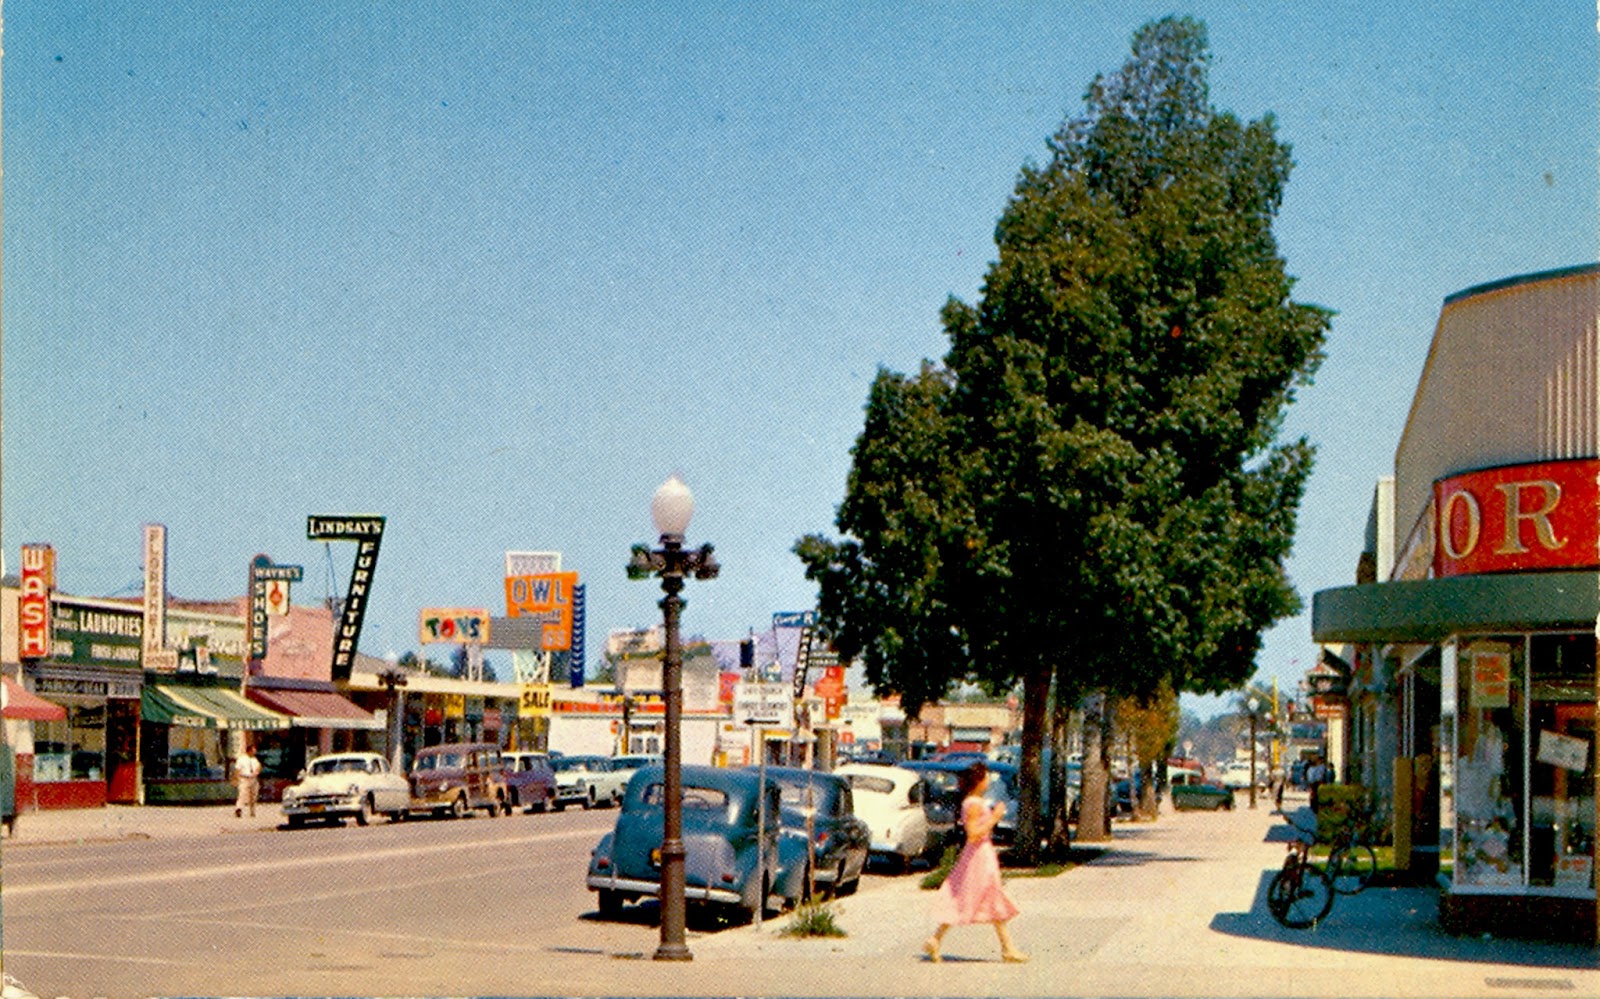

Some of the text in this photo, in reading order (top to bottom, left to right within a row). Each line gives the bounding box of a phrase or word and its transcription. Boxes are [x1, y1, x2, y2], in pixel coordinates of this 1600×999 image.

[308, 517, 382, 536] LINDSAY'S
[22, 549, 45, 652] WASH
[335, 541, 375, 667] FURNITURE
[512, 579, 567, 604] OWL
[79, 609, 143, 638] LAUNDRIES
[254, 582, 265, 654] SHOES
[424, 616, 481, 639] TOYS
[523, 691, 550, 709] SALE
